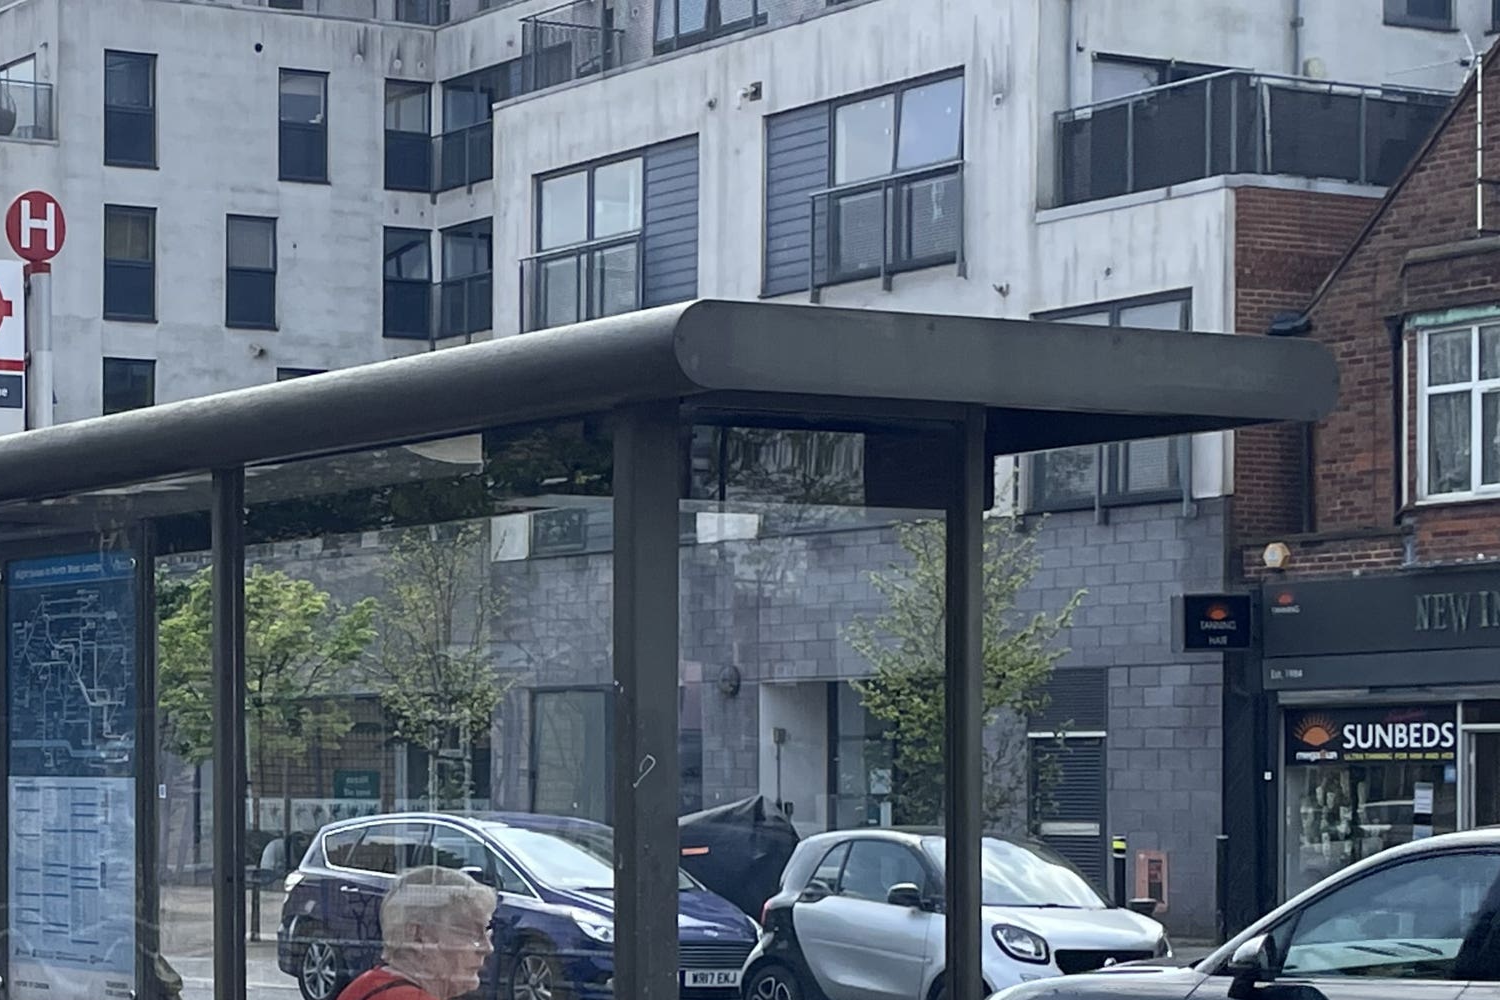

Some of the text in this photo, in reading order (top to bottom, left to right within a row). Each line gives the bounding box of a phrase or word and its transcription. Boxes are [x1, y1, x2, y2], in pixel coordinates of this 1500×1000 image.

[20, 199, 55, 251] H
[1413, 592, 1471, 632] NEW
[1342, 722, 1455, 749] SUNBEDS
